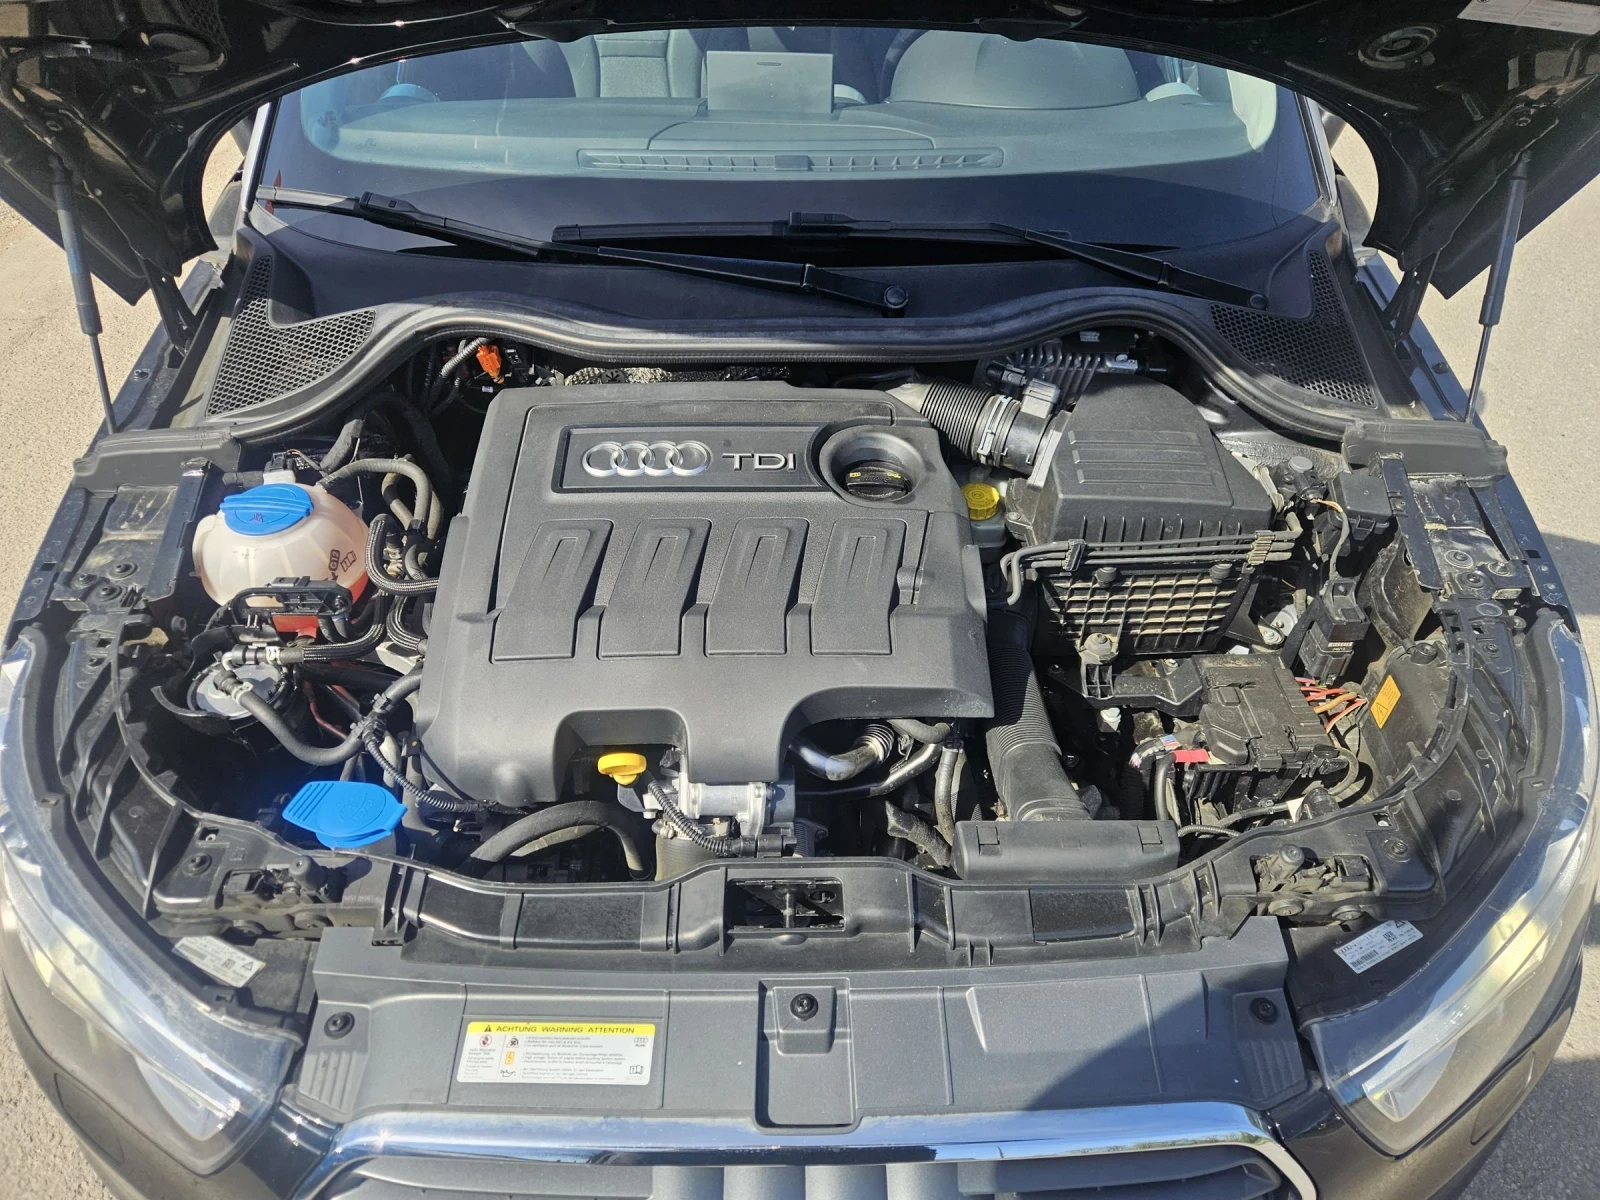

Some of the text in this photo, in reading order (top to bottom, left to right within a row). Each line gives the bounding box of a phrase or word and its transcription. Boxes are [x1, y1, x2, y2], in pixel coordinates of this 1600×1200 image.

[722, 452, 796, 473] TDI
[330, 551, 339, 569] G12
[496, 1025, 537, 1033] ACHTUNG
[542, 1026, 583, 1034] WARNING
